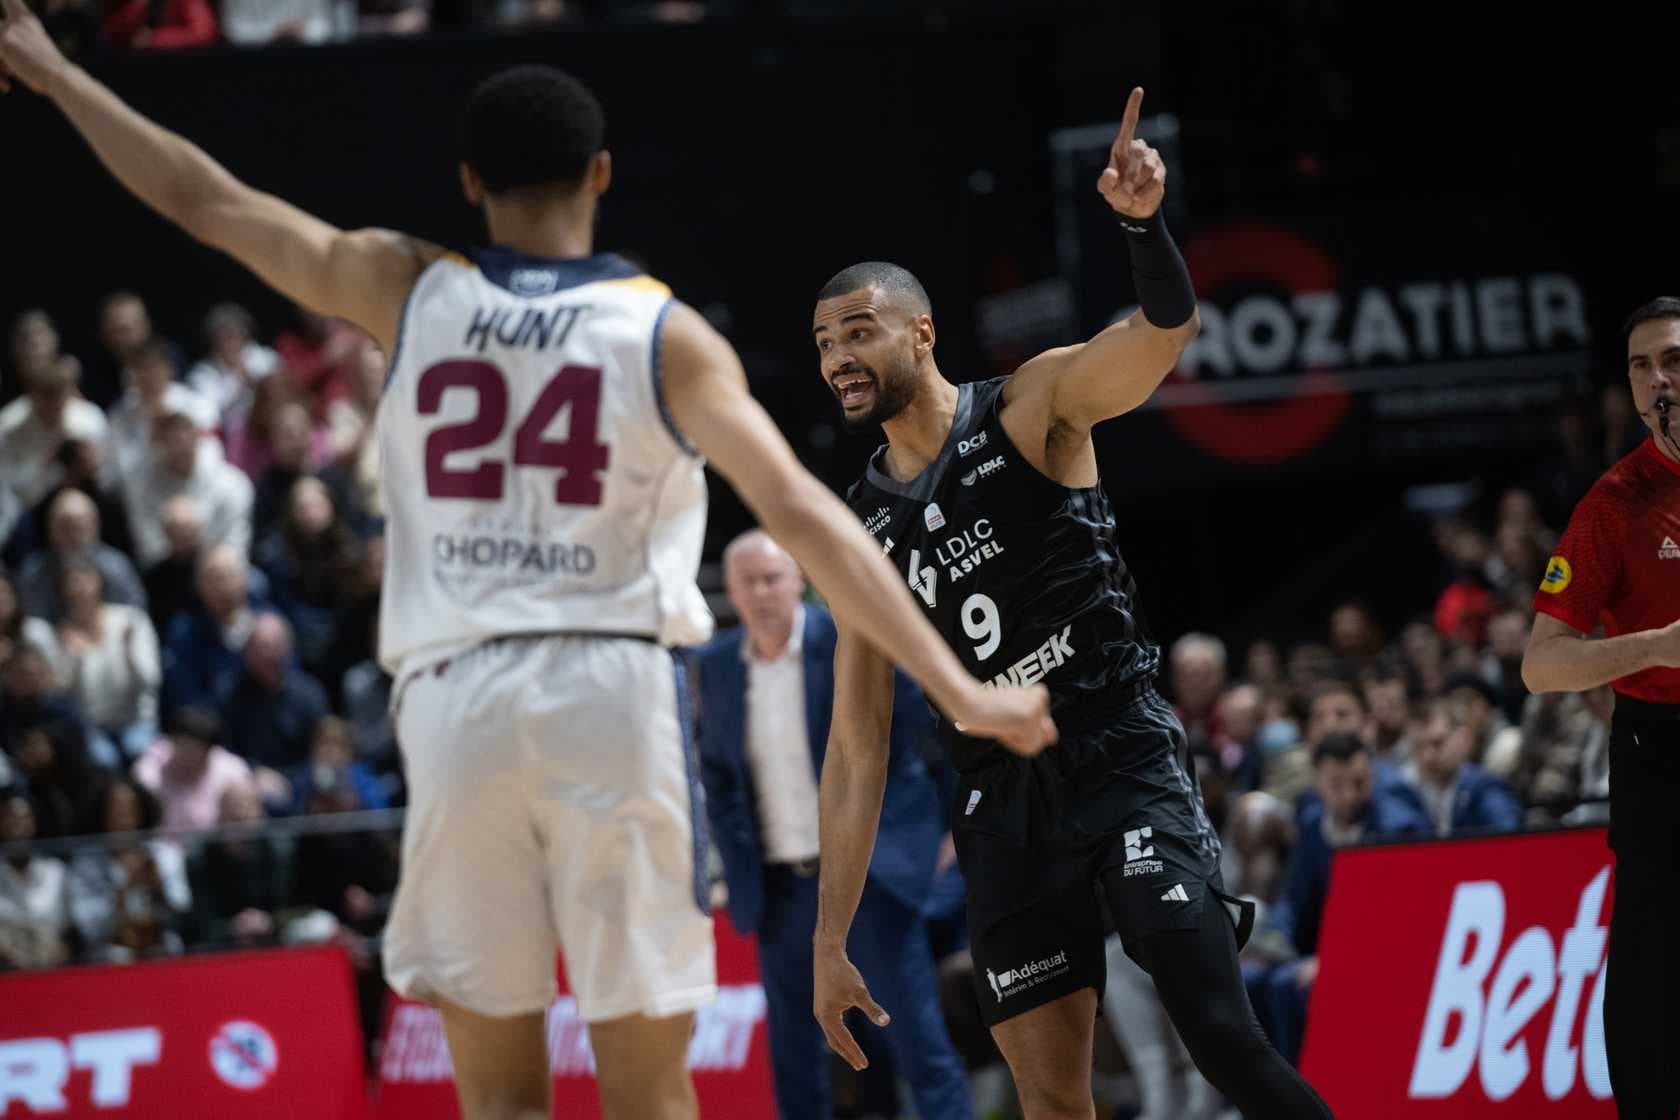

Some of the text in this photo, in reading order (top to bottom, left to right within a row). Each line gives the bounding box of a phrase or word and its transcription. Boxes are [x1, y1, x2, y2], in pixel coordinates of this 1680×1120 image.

[465, 304, 594, 351] HUNT
[1110, 273, 1590, 377] ROZATIER
[416, 356, 612, 507] 24
[977, 455, 1005, 475] LDLC
[434, 533, 596, 577] CHOPARD
[936, 518, 993, 566] LDLC
[950, 540, 1004, 582] ASVEL
[1657, 549, 1680, 560] PEA
[960, 593, 1001, 661] 9
[1135, 865, 1164, 875] FUTUR
[1011, 949, 1067, 983] Adéquat
